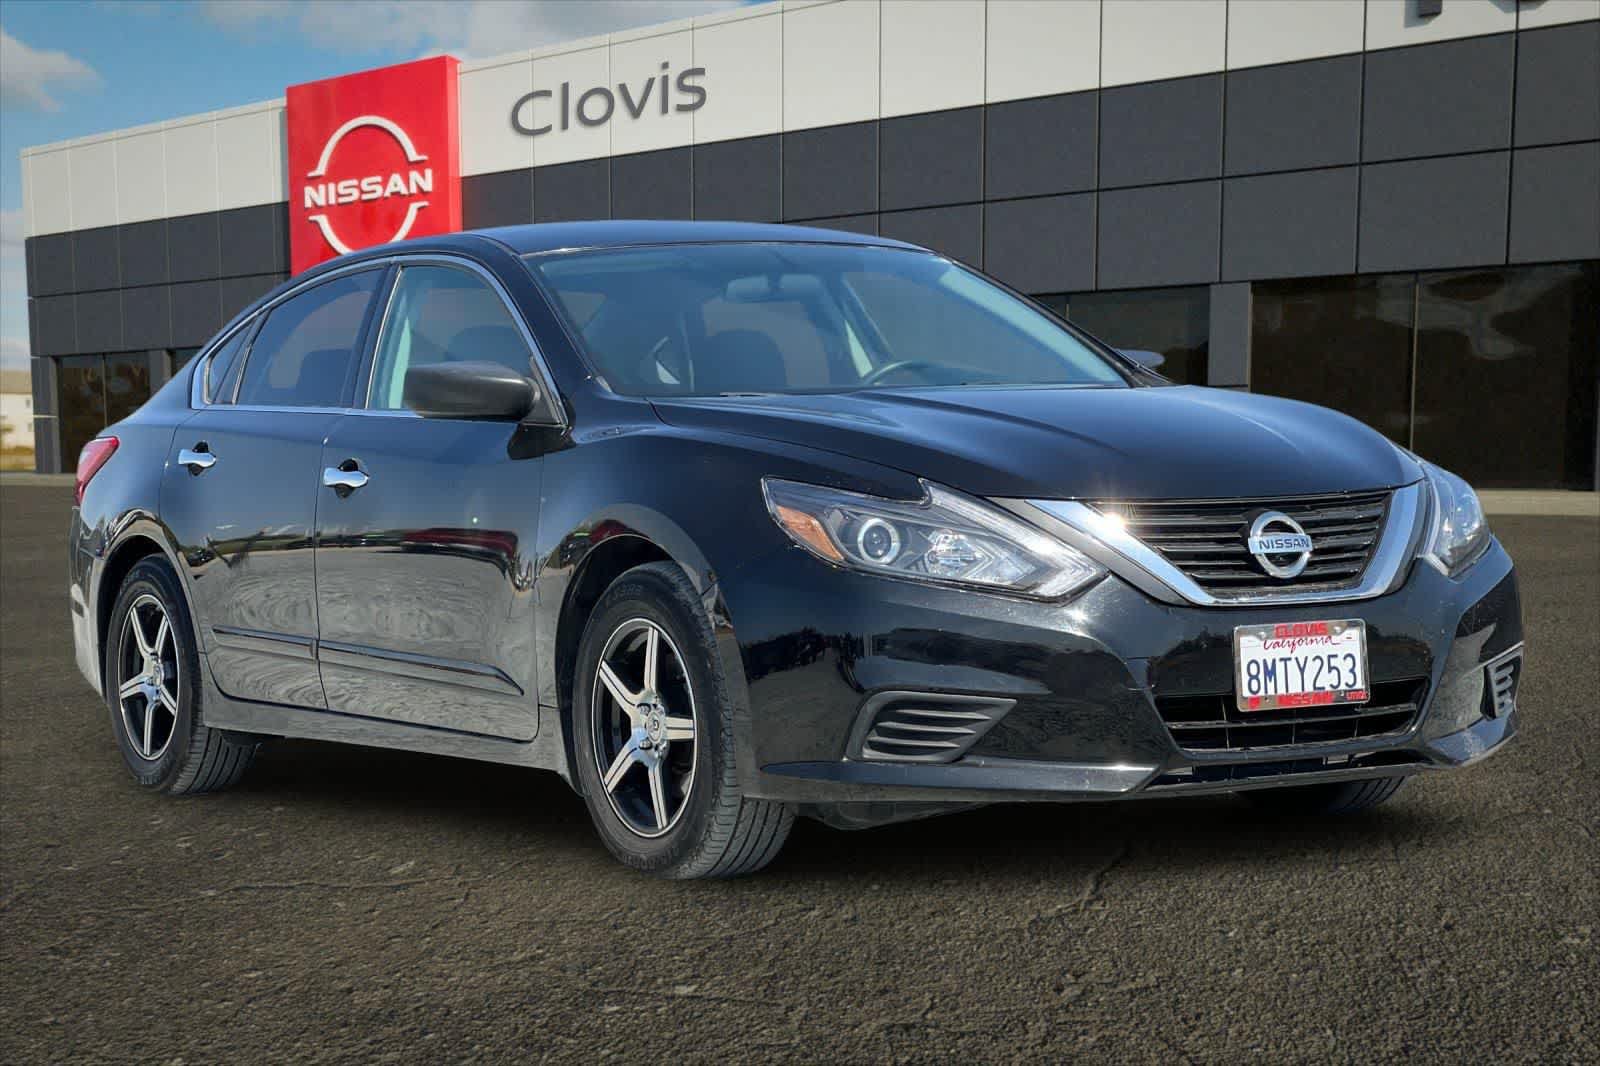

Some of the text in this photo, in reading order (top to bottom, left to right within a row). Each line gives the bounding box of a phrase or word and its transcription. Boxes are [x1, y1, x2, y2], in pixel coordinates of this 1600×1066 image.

[511, 61, 707, 136] Clovis
[303, 168, 433, 208] NISSAN
[1259, 538, 1310, 550] NISSAN
[1263, 634, 1340, 654] California
[1246, 653, 1358, 695] 8MTY253
